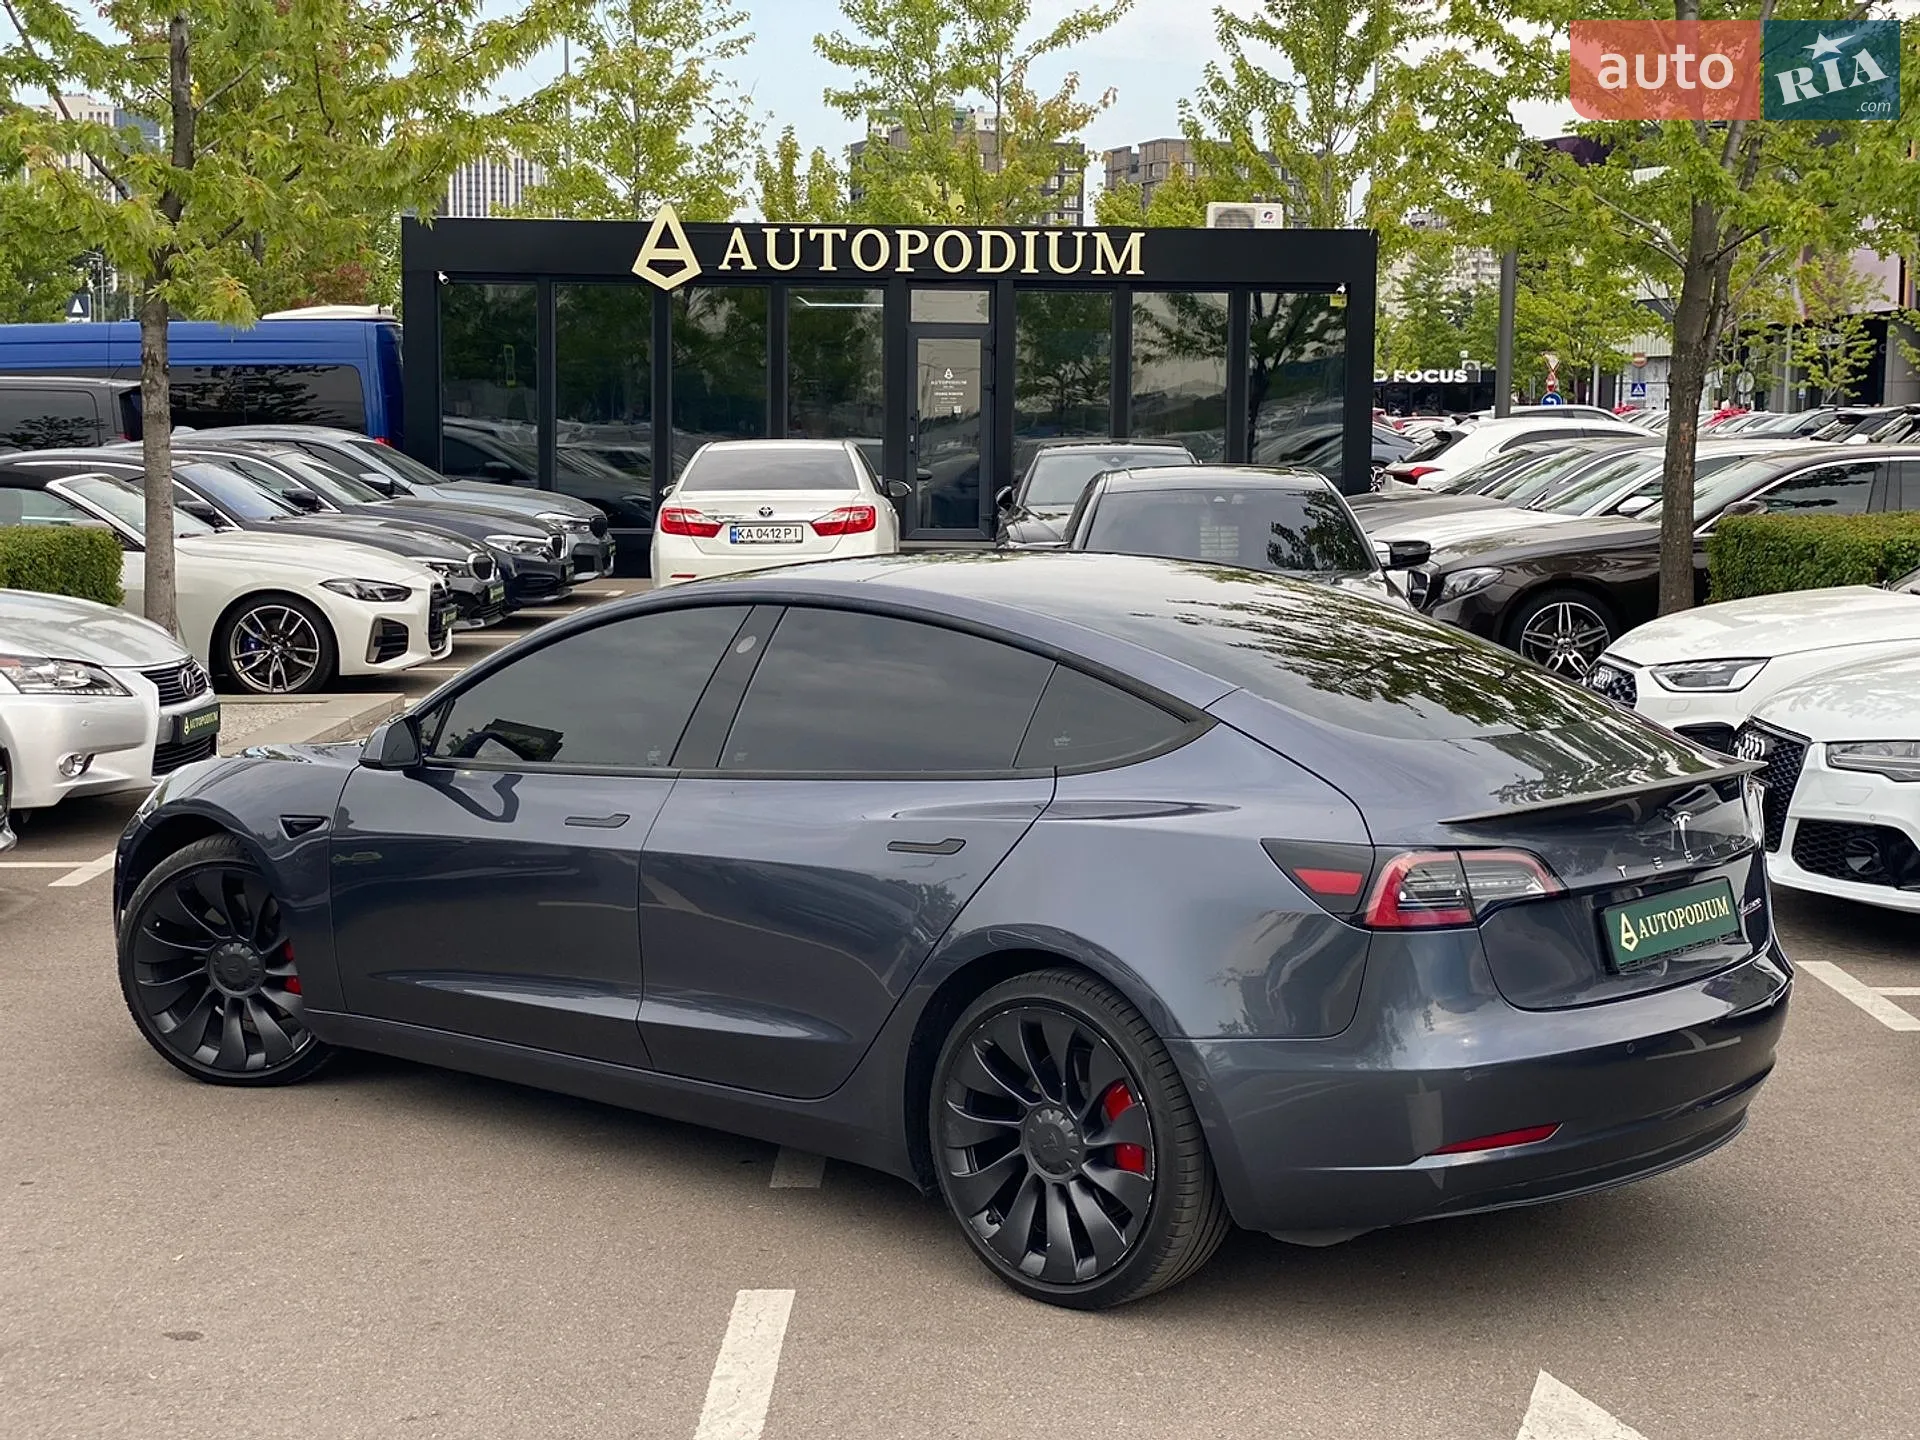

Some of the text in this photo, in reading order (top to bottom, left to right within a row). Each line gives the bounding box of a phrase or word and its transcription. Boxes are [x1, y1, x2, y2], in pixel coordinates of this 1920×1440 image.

[717, 227, 1145, 275] AUTOPODIUM
[1393, 369, 1468, 383] FOCUS
[737, 528, 754, 539] KA
[756, 528, 781, 539] 0412
[1639, 896, 1730, 939] AUTOPODIUM
